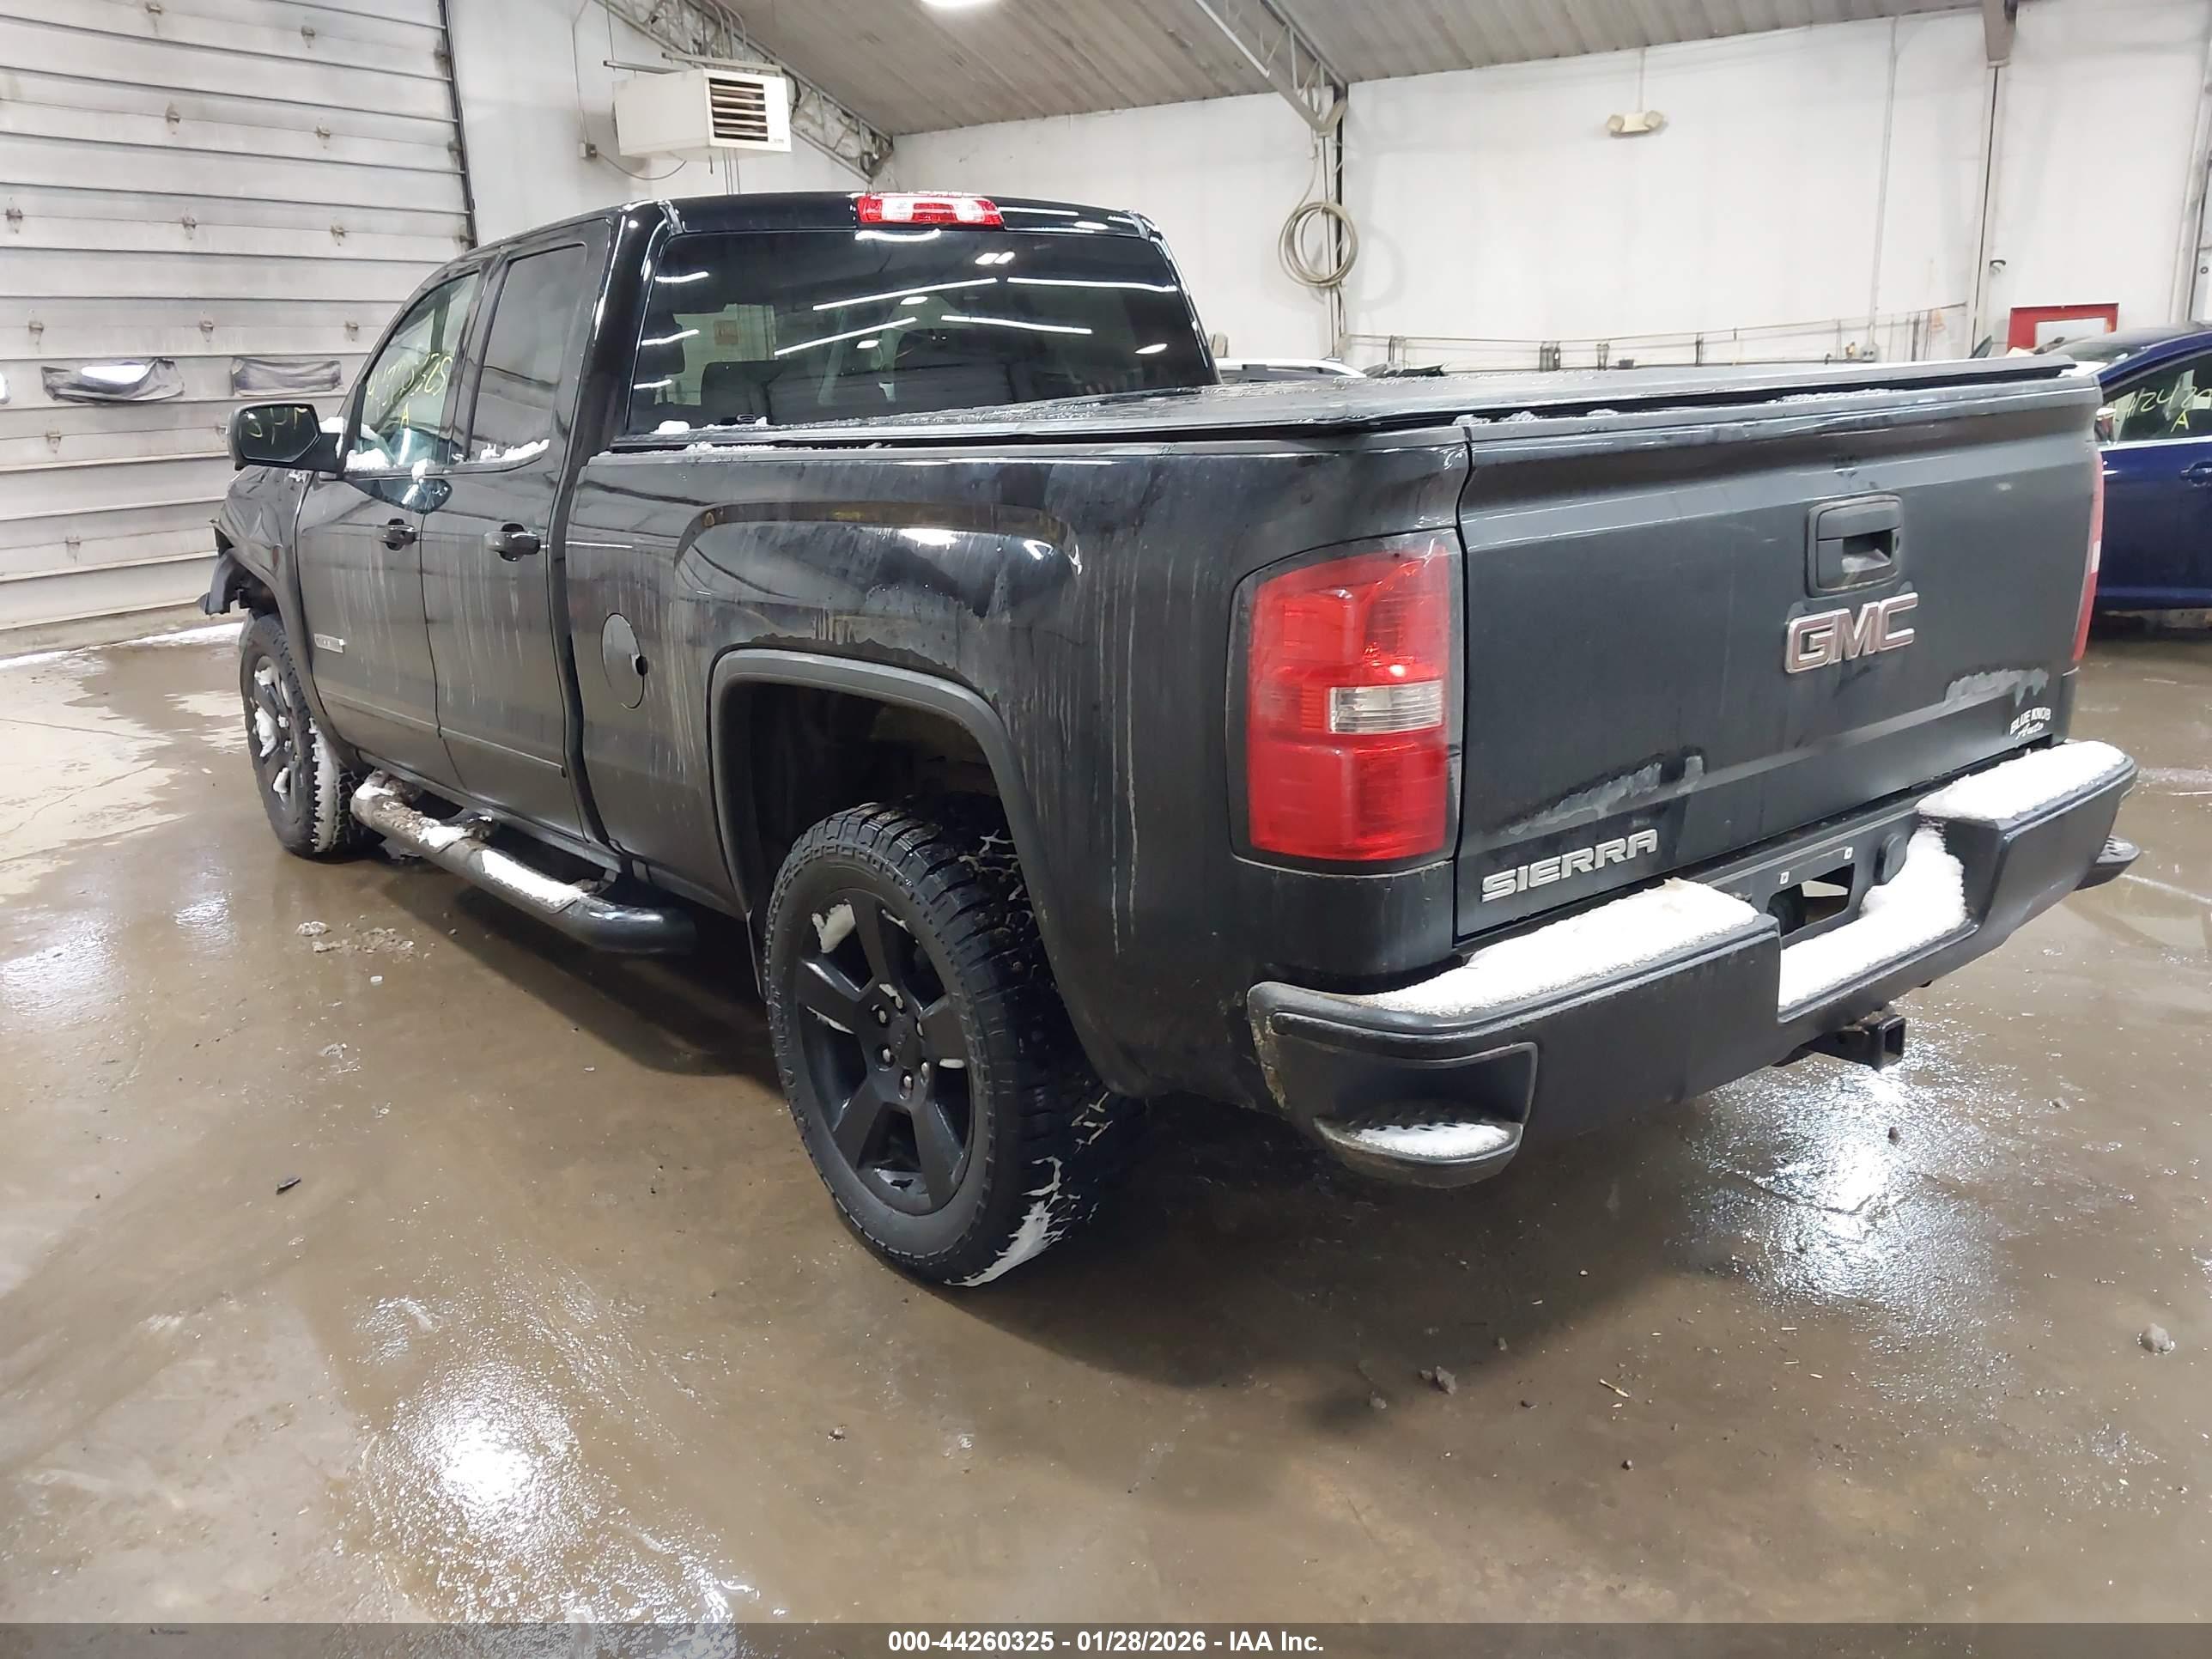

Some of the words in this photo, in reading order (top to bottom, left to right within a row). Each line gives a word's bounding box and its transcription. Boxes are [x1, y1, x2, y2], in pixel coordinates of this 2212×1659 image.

[2170, 410, 2190, 432] A
[1785, 592, 1918, 673] GMC
[1481, 829, 1658, 902] SIERRA
